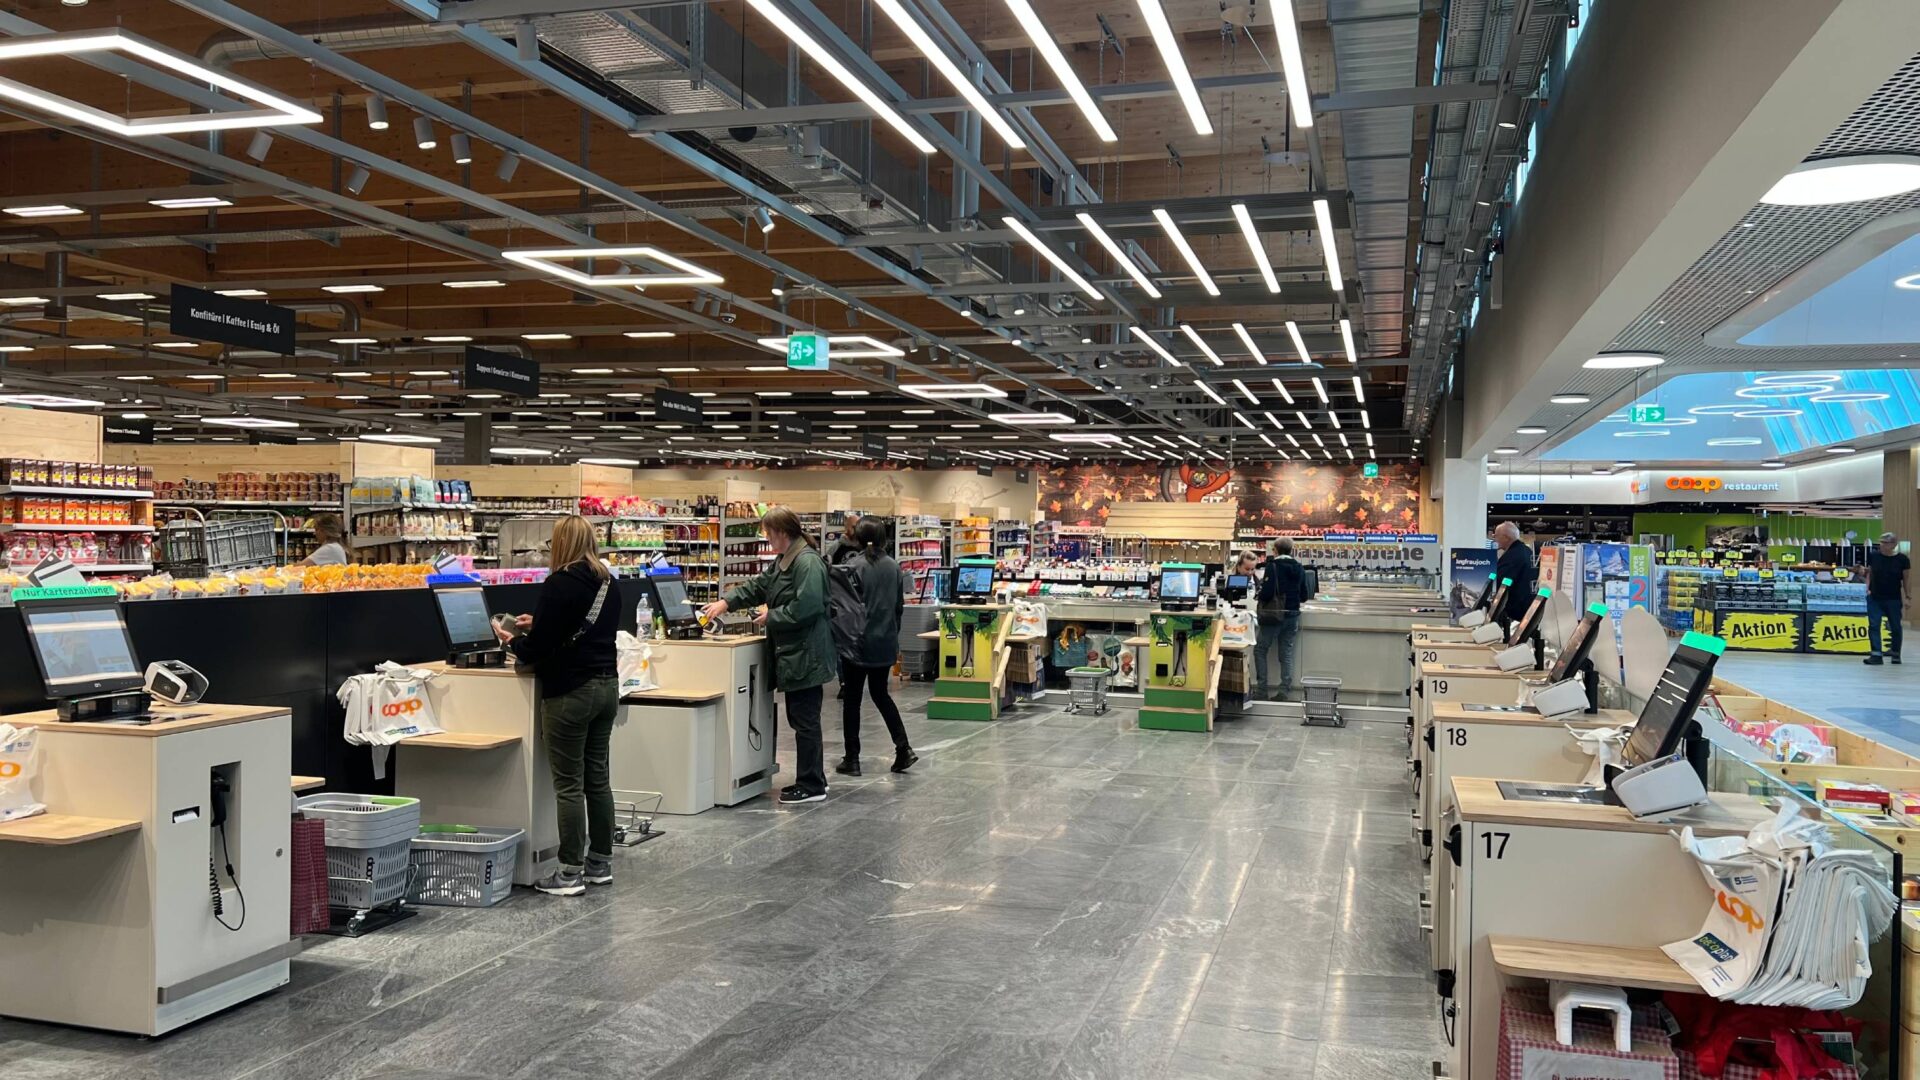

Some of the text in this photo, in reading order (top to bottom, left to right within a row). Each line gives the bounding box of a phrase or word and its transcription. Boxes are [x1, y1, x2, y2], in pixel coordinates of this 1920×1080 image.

[190, 307, 222, 323] Konfitüre
[226, 315, 247, 328] Kaffee
[250, 321, 265, 333] Essig
[272, 322, 280, 334] Öl
[1665, 476, 1779, 494] coop restaurant
[22, 586, 110, 598] Nur Kartenzahlung
[1731, 621, 1787, 639] Aktion
[1822, 624, 1870, 642] Aktio
[1422, 651, 1437, 663] 20
[1432, 680, 1448, 694] 19
[381, 698, 423, 717] coop
[1446, 728, 1467, 746] 18
[1481, 832, 1511, 860] 17
[485, 860, 493, 885] coop
